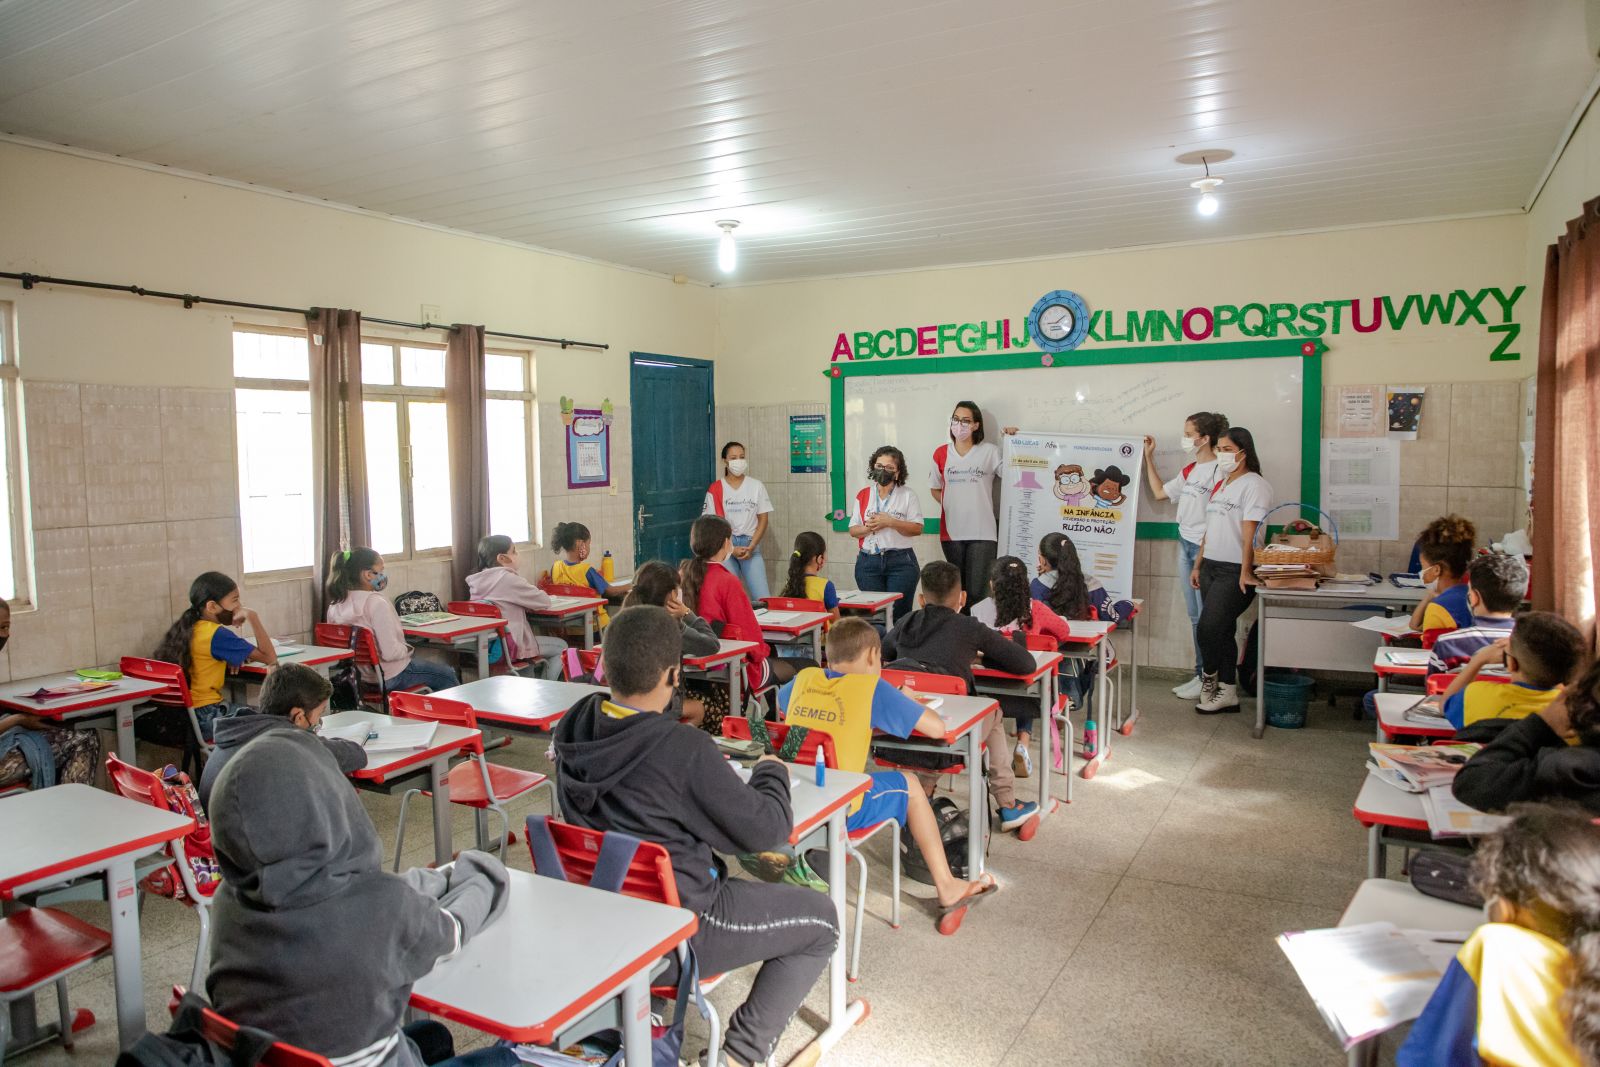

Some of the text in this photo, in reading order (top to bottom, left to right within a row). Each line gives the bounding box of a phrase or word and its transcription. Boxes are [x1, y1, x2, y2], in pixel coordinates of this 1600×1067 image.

[1076, 509, 1115, 519] INFÂNCIA
[1062, 522, 1116, 535] RUÍDO NÃO!
[793, 706, 837, 722] SEMED
